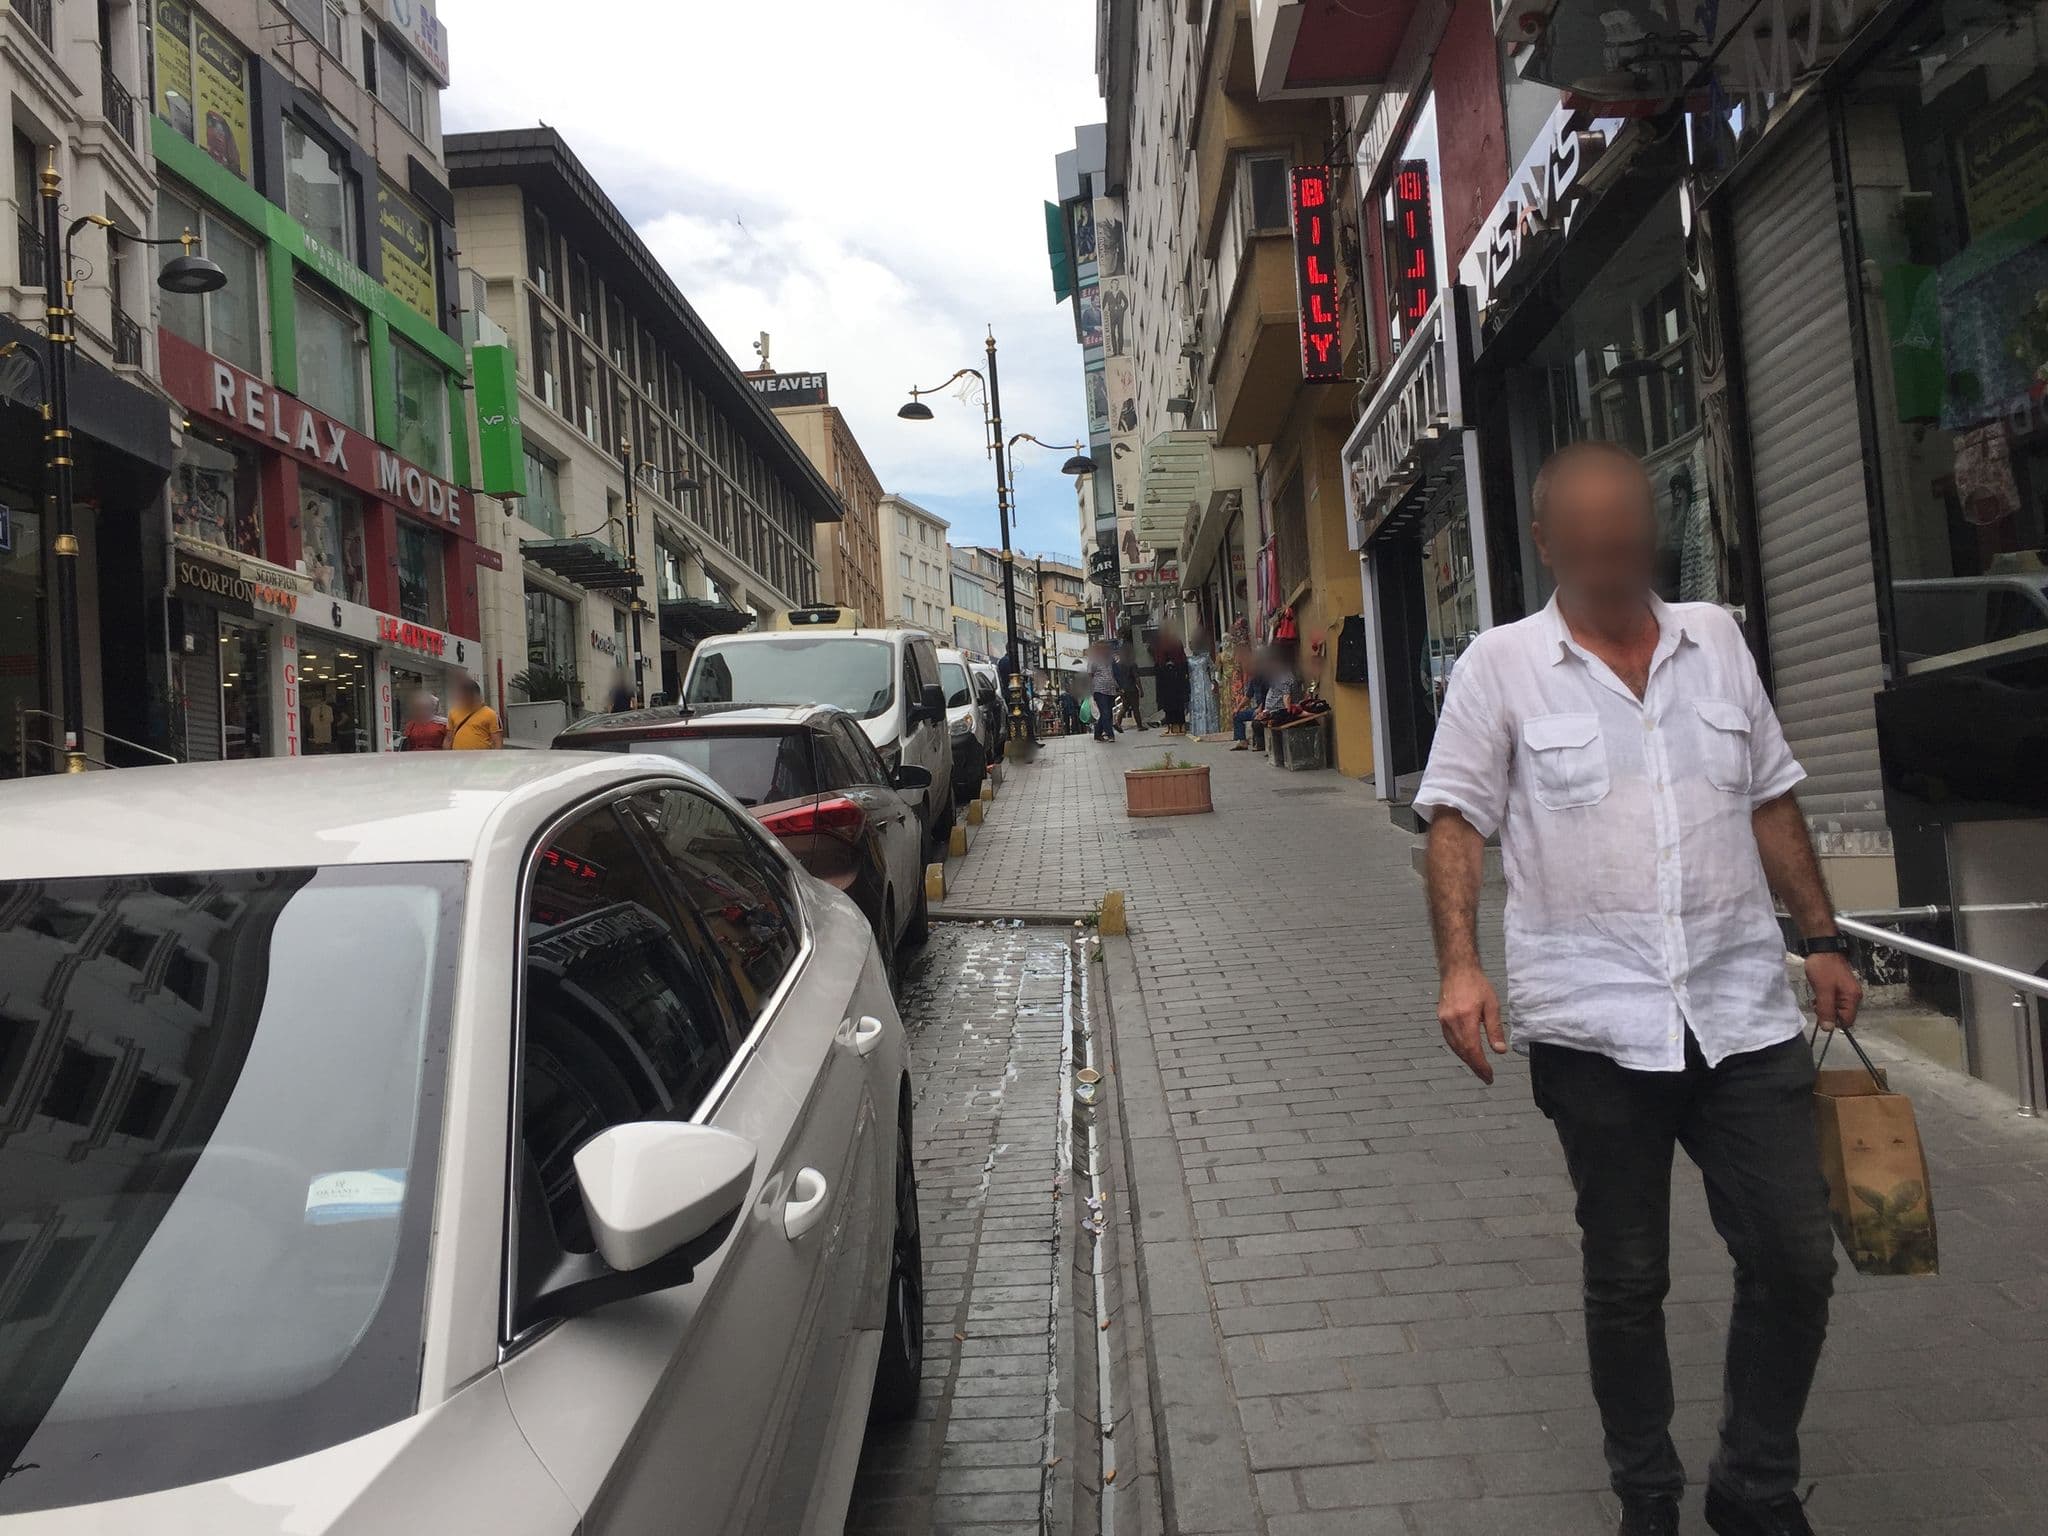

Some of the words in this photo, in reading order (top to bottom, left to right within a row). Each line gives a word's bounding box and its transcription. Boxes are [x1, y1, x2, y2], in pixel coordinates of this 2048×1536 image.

[1302, 178, 1333, 362] BILLY
[750, 376, 823, 393] WEAVER
[213, 362, 349, 472] RELAX
[377, 450, 461, 526] MODE
[180, 561, 256, 604] SCORPION
[256, 568, 298, 591] SCORPION
[379, 615, 398, 643] LE
[401, 622, 444, 657] GUTTI
